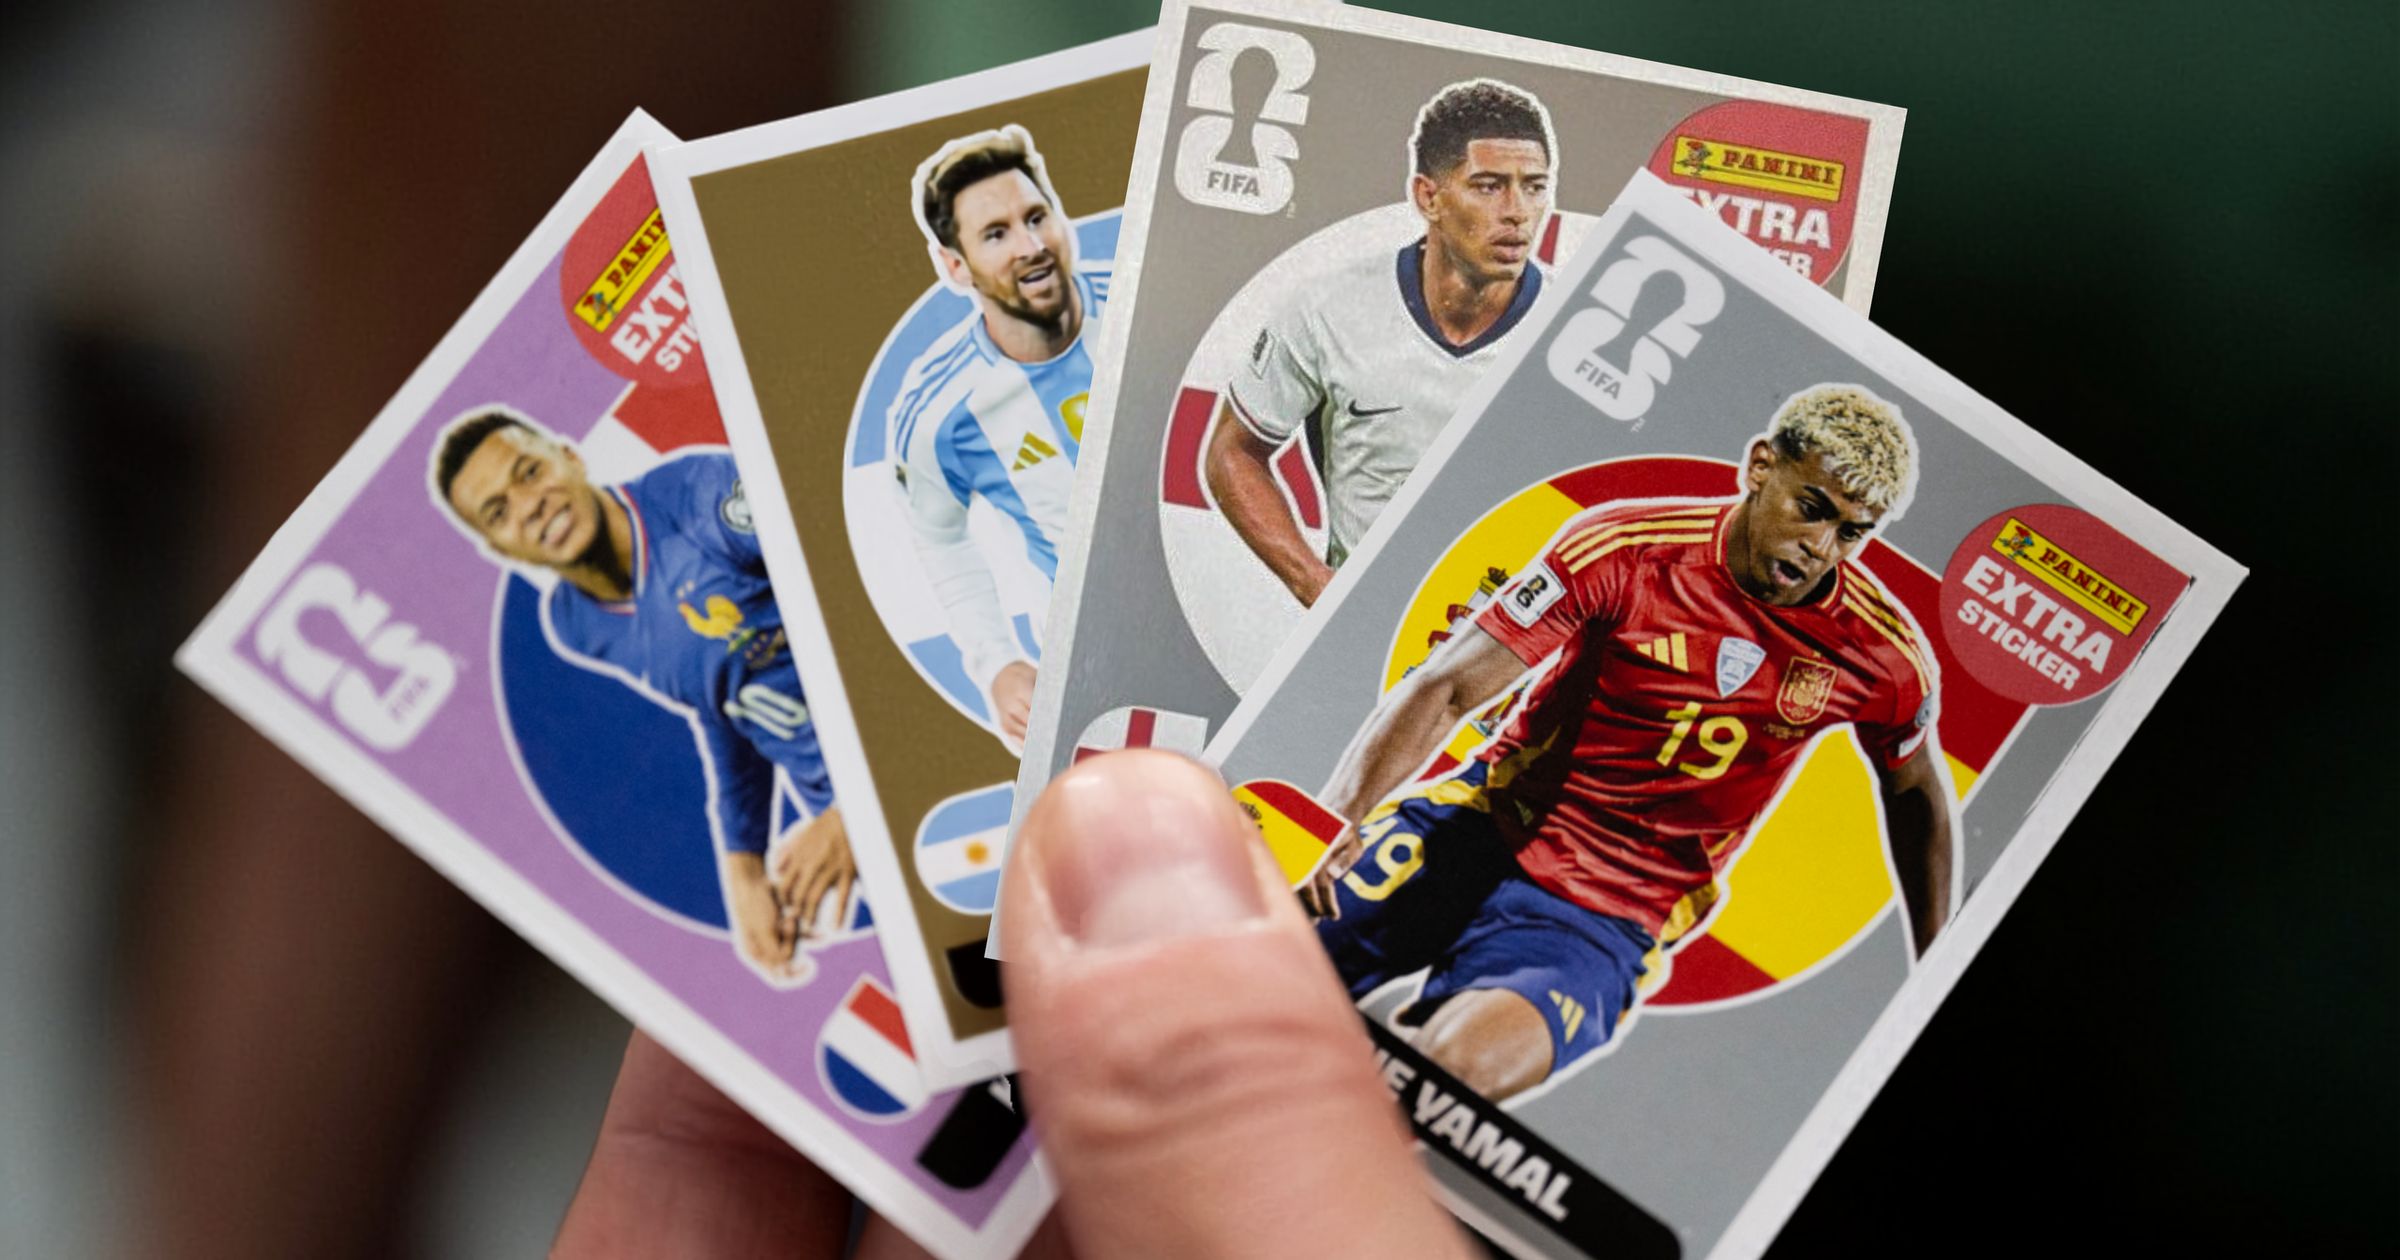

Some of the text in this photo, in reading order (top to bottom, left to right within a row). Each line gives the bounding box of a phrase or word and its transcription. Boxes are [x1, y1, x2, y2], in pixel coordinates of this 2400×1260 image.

[1207, 170, 1260, 197] FIFA
[1721, 149, 1837, 185] PANINI
[1574, 358, 1622, 400] FIFA
[1961, 554, 2114, 675] EXTRA
[2038, 546, 2141, 621] PANINI
[1957, 598, 2081, 691] STICKER
[723, 683, 808, 741] 10
[1655, 700, 1749, 781] 19
[1413, 1078, 1572, 1222] YAMAL
